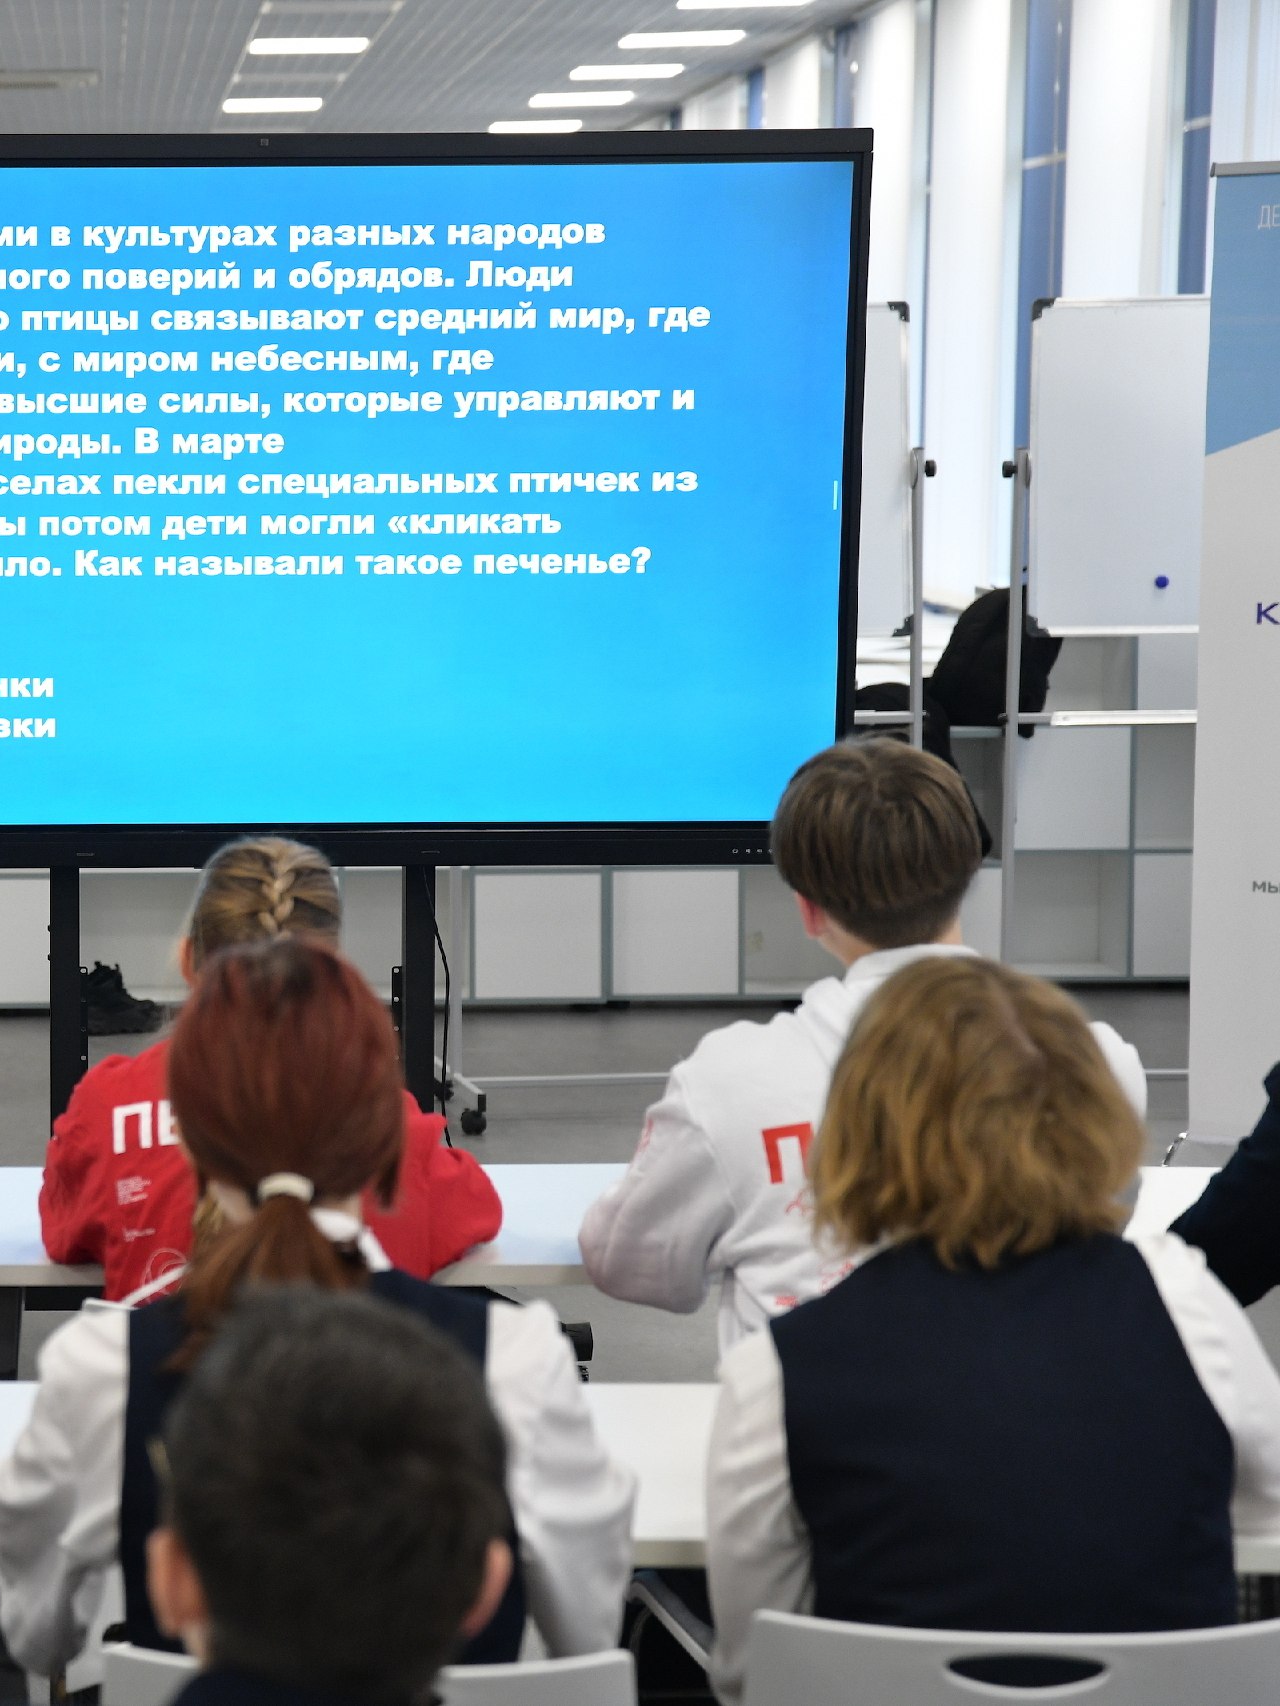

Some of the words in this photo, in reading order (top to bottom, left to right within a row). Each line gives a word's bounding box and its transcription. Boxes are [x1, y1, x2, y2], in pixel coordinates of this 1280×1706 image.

[50, 225, 71, 247] в
[83, 225, 278, 254] культурах
[289, 224, 436, 253] разных
[447, 223, 606, 252] народов
[82, 261, 241, 296] поверий
[253, 268, 276, 289] и
[288, 260, 455, 295] обрядов.
[465, 260, 573, 292] Люди
[21, 310, 139, 336] птицы
[150, 309, 365, 331] связывают
[374, 301, 537, 337] средний
[549, 307, 635, 335] мир,
[648, 306, 711, 333] где
[38, 351, 61, 373] с
[73, 351, 198, 379] миром
[211, 343, 419, 378] небесным,
[432, 349, 495, 376] где
[158, 392, 271, 419] силы,
[283, 391, 443, 419] которые
[453, 389, 661, 419] управляют
[672, 389, 695, 410] и
[134, 427, 160, 454] В
[172, 433, 285, 461] марте
[113, 473, 226, 495] пекли
[237, 472, 499, 499] специальных
[509, 471, 640, 493] птичек
[651, 471, 699, 492] из
[39, 515, 151, 537] потом
[161, 515, 247, 541] дети
[260, 514, 375, 535] могли
[387, 513, 562, 535] «кликать
[74, 549, 143, 577] Как
[154, 555, 344, 577] называли
[354, 553, 463, 575] такое
[473, 546, 652, 575] печенье?
